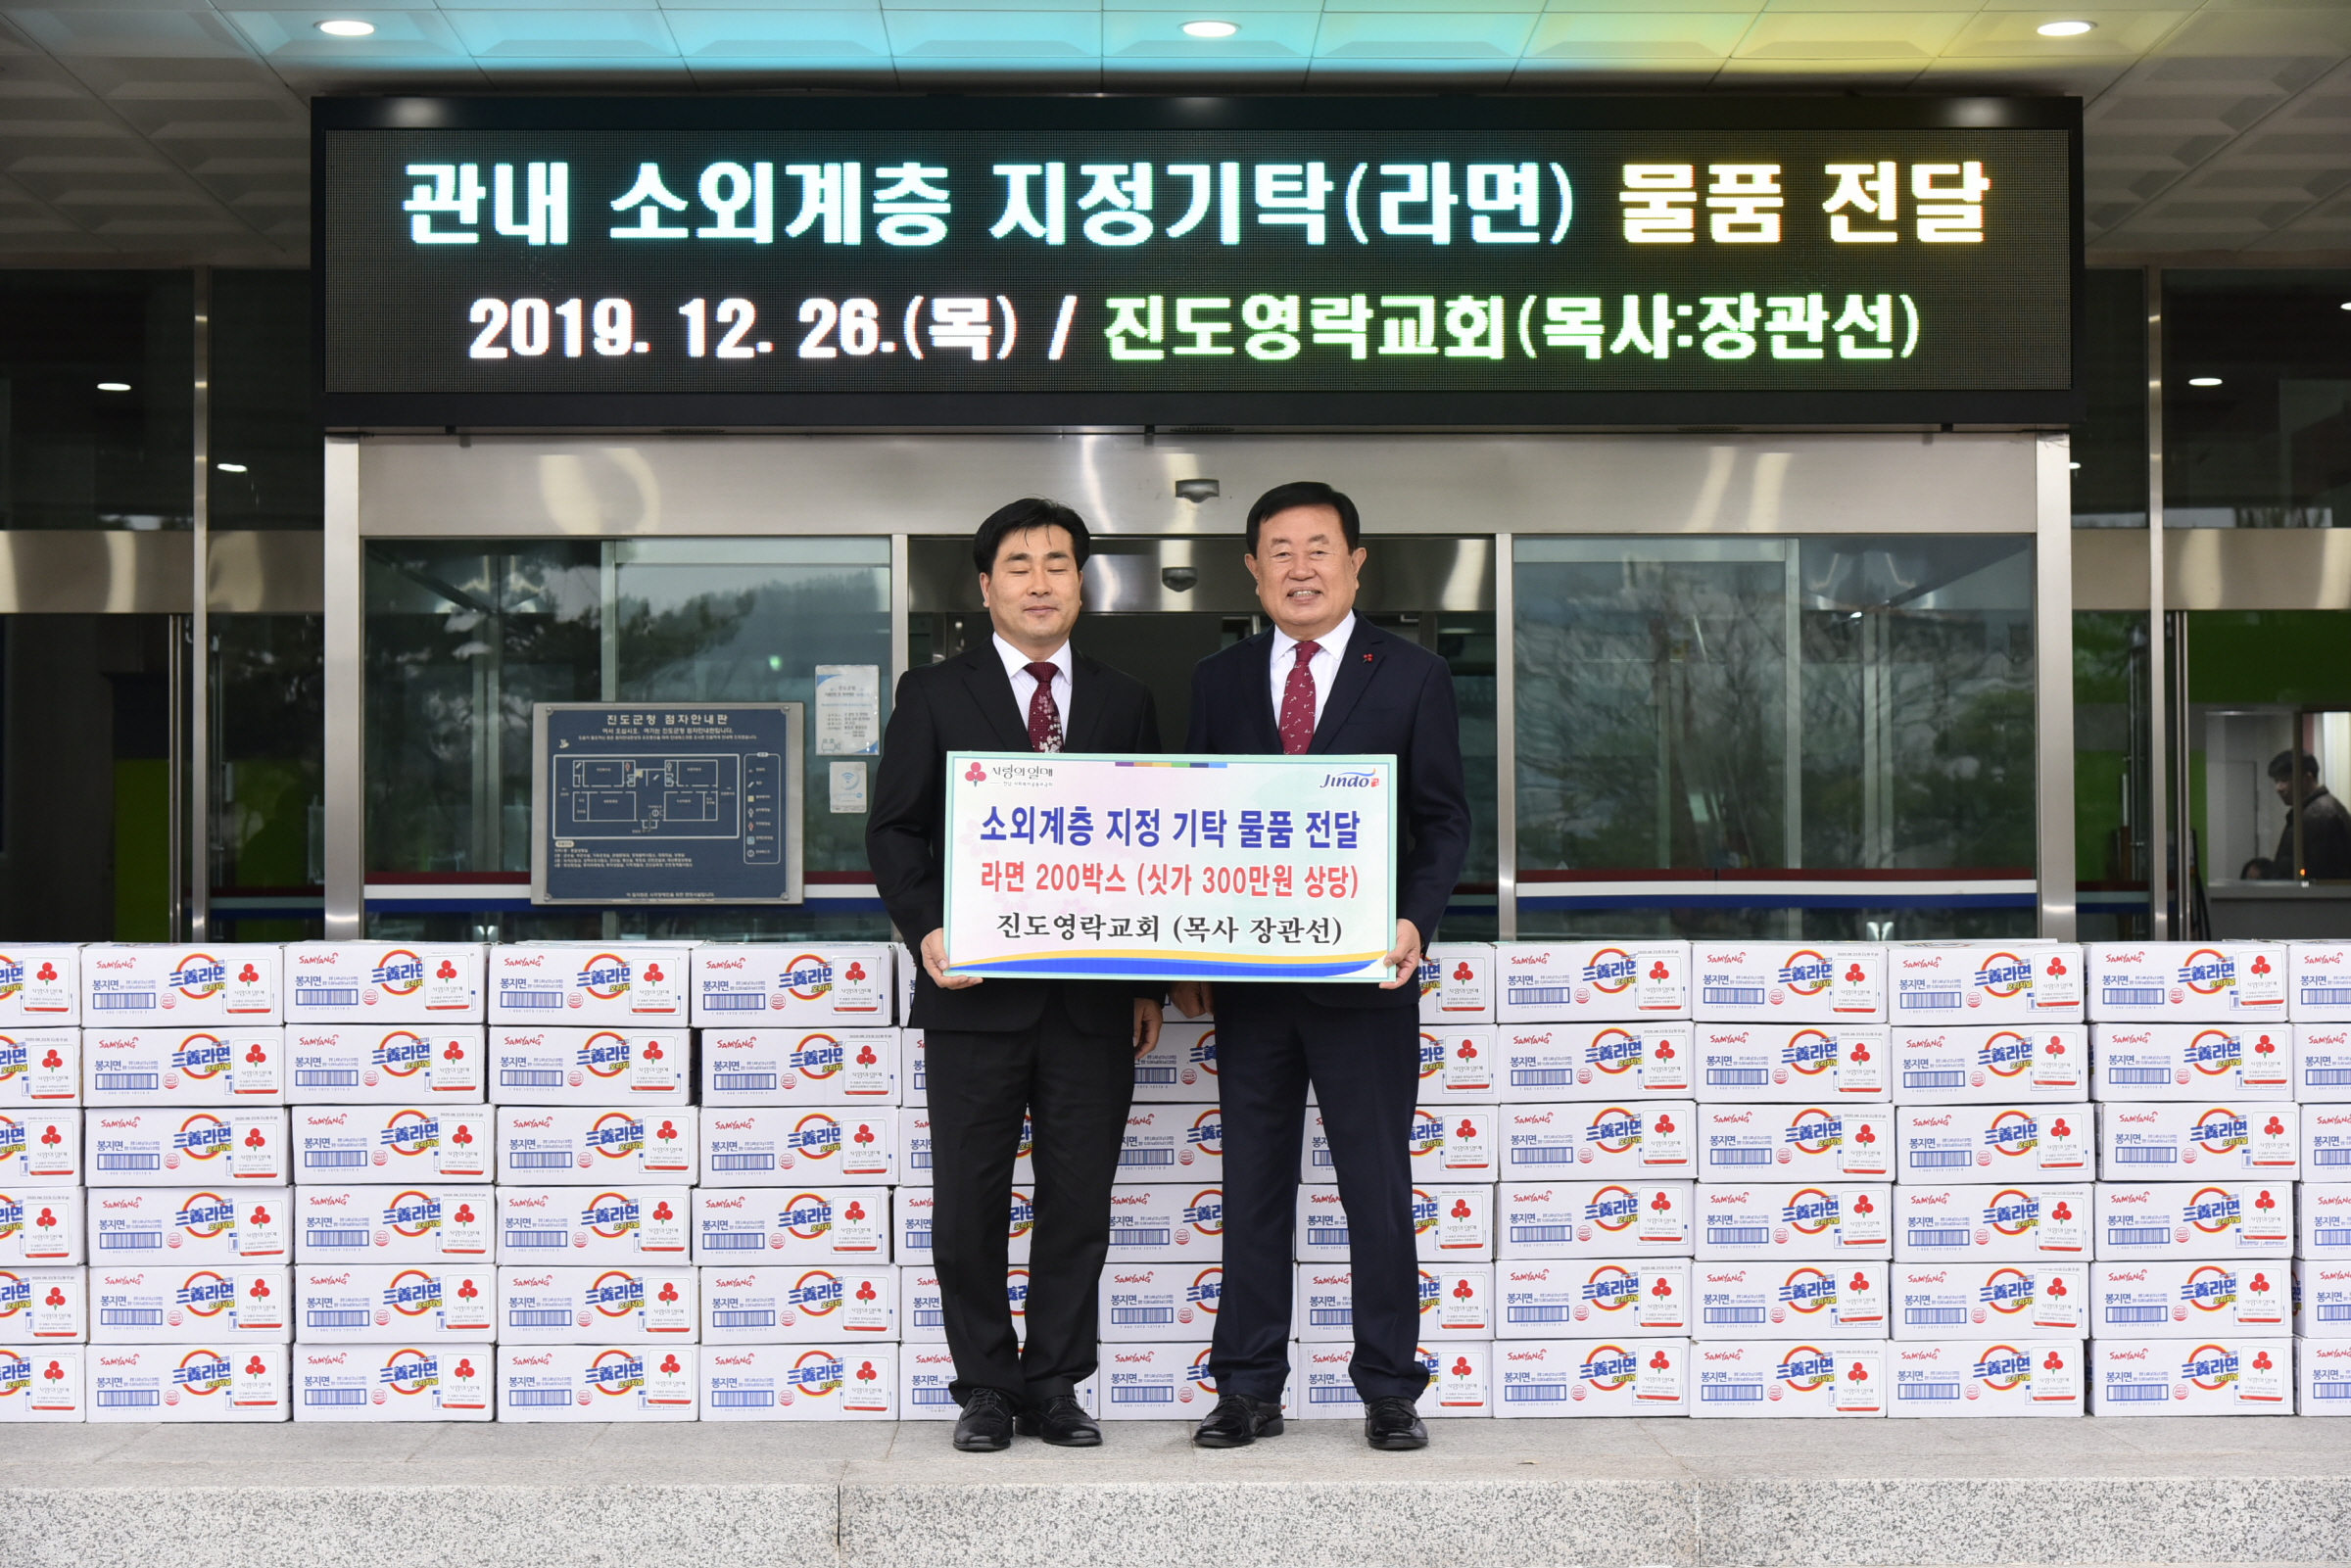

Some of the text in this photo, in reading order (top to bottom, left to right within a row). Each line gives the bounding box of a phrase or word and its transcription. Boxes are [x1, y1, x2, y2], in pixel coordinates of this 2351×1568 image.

[403, 162, 1992, 248] 관내 소외계층 지정기탁(라면) 물품 전달
[469, 293, 1921, 363] 2019. 12. 26.(목) / 진도영락교회(목사:장관선)
[606, 714, 728, 726] 진도군청 점자안내판
[1319, 772, 1370, 788] Jindo
[980, 805, 1361, 849] 소외계층 지정 기탁 물품 전달
[981, 860, 1358, 899] 라면 200박스 (싯가 300만원 상당)
[996, 912, 1343, 946] 진도영락교회 (목사 장관선)
[96, 957, 136, 970] SAMYANG
[298, 952, 338, 965] SAMYANG
[504, 955, 544, 968] SAMYANG
[705, 957, 745, 970] SAMYANG
[1511, 953, 1551, 966] SAMYANG
[1706, 951, 1747, 964] SAMYANG
[1902, 957, 1943, 970] SAMYANG
[2105, 951, 2145, 964] SAMYANG
[500, 977, 528, 990] 봉지면
[1898, 978, 1927, 991] 봉지면
[2101, 974, 2130, 986] 봉지면
[98, 1037, 138, 1050] SAMYANG
[299, 1034, 339, 1047] SAMYANG
[504, 1033, 544, 1046] SAMYANG
[716, 1037, 756, 1050] SAMYANG
[1512, 1032, 1553, 1045] SAMYANG
[1709, 1031, 1750, 1044] SAMYANG
[1905, 1036, 1945, 1049] SAMYANG
[2111, 1031, 2151, 1044] SAMYANG
[94, 1060, 122, 1072] 봉지면
[294, 1056, 322, 1069] 봉지면
[500, 1056, 528, 1069] 봉지면
[1705, 1055, 1734, 1068] 봉지면
[100, 1117, 140, 1129] SAMYANG
[307, 1114, 347, 1126] SAMYANG
[512, 1117, 552, 1129] SAMYANG
[714, 1117, 754, 1130] SAMYANG
[1513, 1113, 1554, 1125] SAMYANG
[1712, 1112, 1752, 1124] SAMYANG
[1912, 1115, 1952, 1127] SAMYANG
[2118, 1111, 2158, 1123] SAMYANG
[508, 1138, 537, 1151] 봉지면
[1510, 1133, 1538, 1146] 봉지면
[1708, 1134, 1737, 1147] 봉지면
[1908, 1137, 1937, 1150] 봉지면
[2114, 1132, 2142, 1145] 봉지면
[96, 1140, 124, 1153] 봉지면
[710, 1140, 739, 1153] 봉지면
[310, 1194, 350, 1207] SAMYANG
[508, 1195, 549, 1208] SAMYANG
[1512, 1190, 1553, 1203] SAMYANG
[1709, 1192, 1750, 1205] SAMYANG
[1910, 1193, 1950, 1206] SAMYANG
[2110, 1191, 2150, 1204] SAMYANG
[102, 1197, 142, 1210] SAMYANG
[705, 1197, 745, 1210] SAMYANG
[98, 1218, 126, 1231] 봉지면
[1509, 1212, 1537, 1225] 봉지면
[1705, 1213, 1734, 1226] 봉지면
[1906, 1215, 1935, 1228] 봉지면
[701, 1219, 730, 1232] 봉지면
[104, 1273, 144, 1286] SAMYANG
[310, 1273, 350, 1286] SAMYANG
[512, 1275, 552, 1288] SAMYANG
[715, 1275, 755, 1288] SAMYANG
[1114, 1271, 1154, 1284] SAMYANG
[1510, 1269, 1550, 1282] SAMYANG
[1706, 1270, 1747, 1283] SAMYANG
[1907, 1271, 1947, 1284] SAMYANG
[2107, 1269, 2147, 1282] SAMYANG
[306, 1297, 334, 1309] 봉지면
[508, 1296, 537, 1308] 봉지면
[711, 1297, 740, 1309] 봉지면
[1110, 1294, 1138, 1307] 봉지면
[1506, 1292, 1534, 1305] 봉지면
[1703, 1293, 1731, 1306] 봉지면
[1903, 1294, 1932, 1307] 봉지면
[2104, 1292, 2133, 1305] 봉지면
[100, 1354, 140, 1366] SAMYANG
[307, 1353, 347, 1365] SAMYANG
[512, 1354, 552, 1366] SAMYANG
[714, 1354, 754, 1366] SAMYANG
[1114, 1351, 1154, 1363] SAMYANG
[1507, 1349, 1547, 1361] SAMYANG
[1703, 1349, 1744, 1361] SAMYANG
[1900, 1348, 1941, 1360] SAMYANG
[2108, 1349, 2148, 1361] SAMYANG
[303, 1375, 331, 1388] 봉지면
[1110, 1372, 1138, 1385] 봉지면
[1896, 1369, 1925, 1382] 봉지면
[2105, 1371, 2134, 1384] 봉지면
[96, 1376, 124, 1389] 봉지면
[710, 1376, 739, 1389] 봉지면
